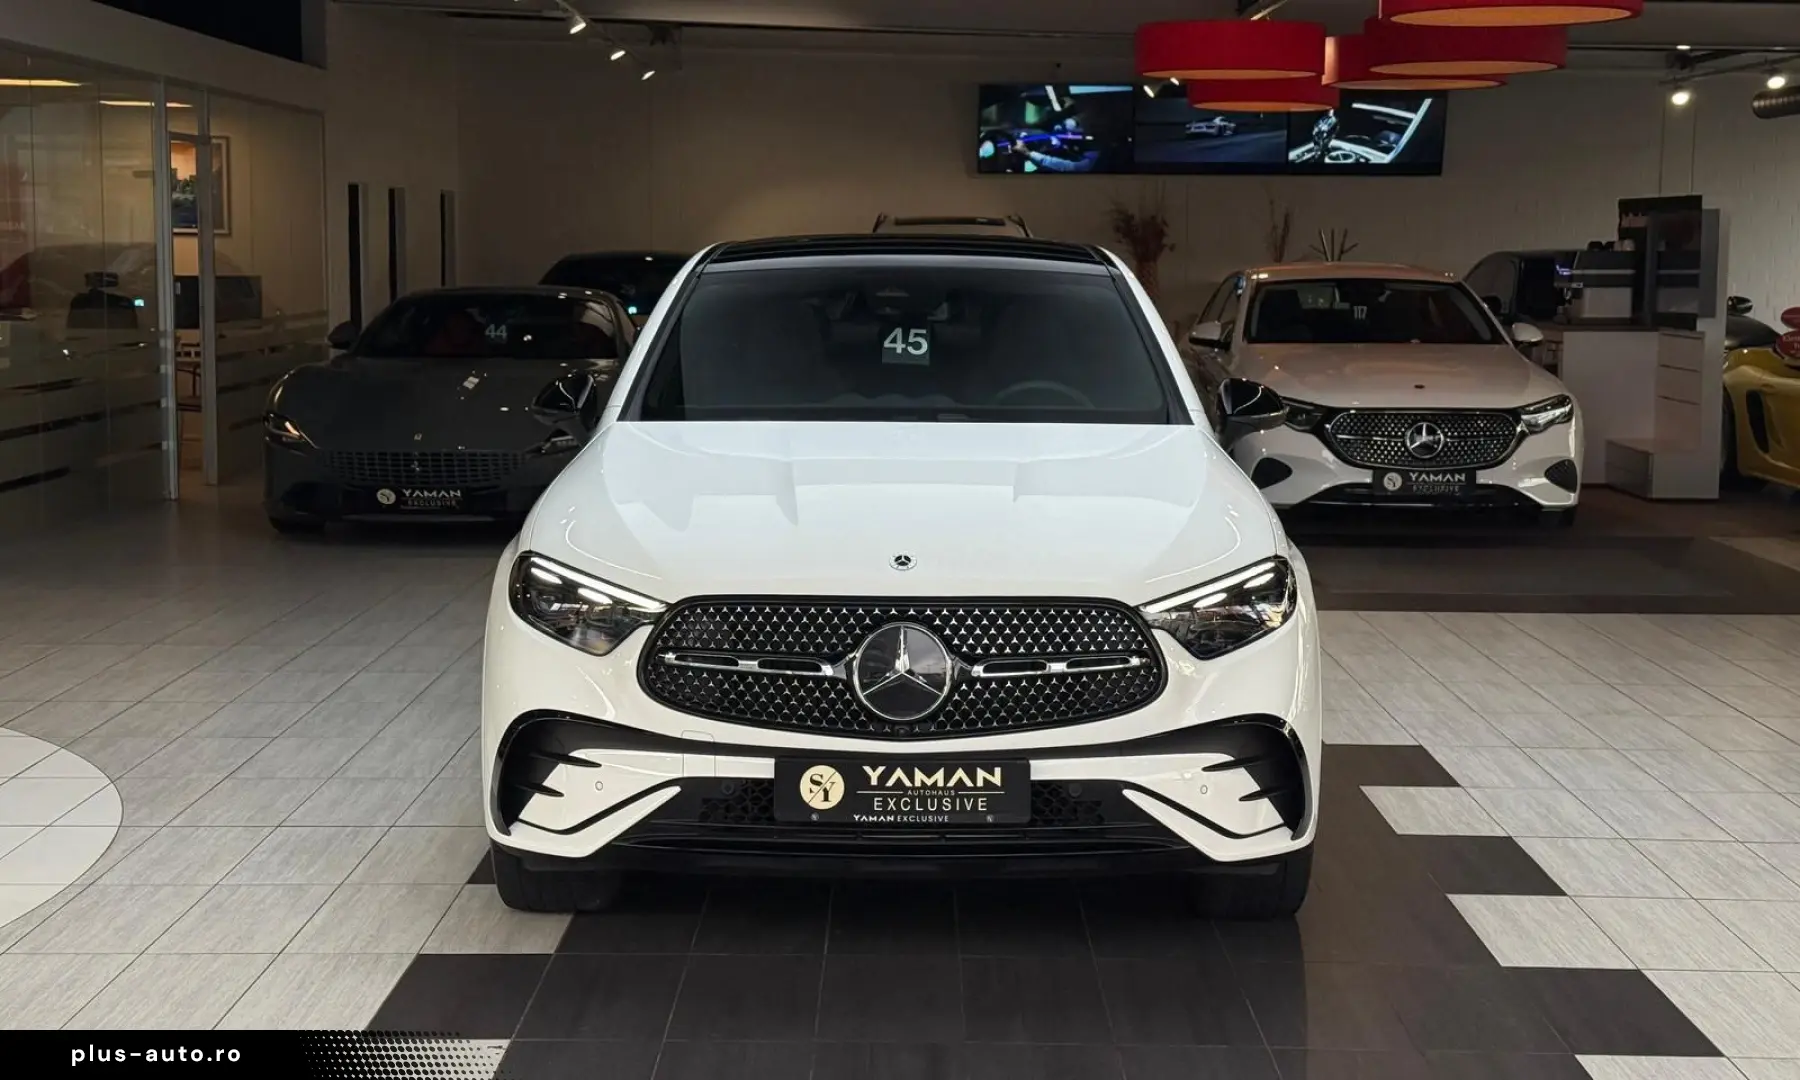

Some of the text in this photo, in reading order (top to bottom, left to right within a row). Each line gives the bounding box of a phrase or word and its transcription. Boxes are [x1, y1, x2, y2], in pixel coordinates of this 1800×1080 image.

[484, 323, 508, 340] 44
[883, 327, 928, 355] 45
[1408, 472, 1466, 482] YAMAN
[401, 488, 461, 498] YAMAN
[407, 498, 457, 507] EXCLUSIVE
[861, 765, 1002, 788] YAMAN
[873, 797, 989, 811] EXCLUSIVE
[853, 814, 949, 823] YAMAN EXCLUSIVE
